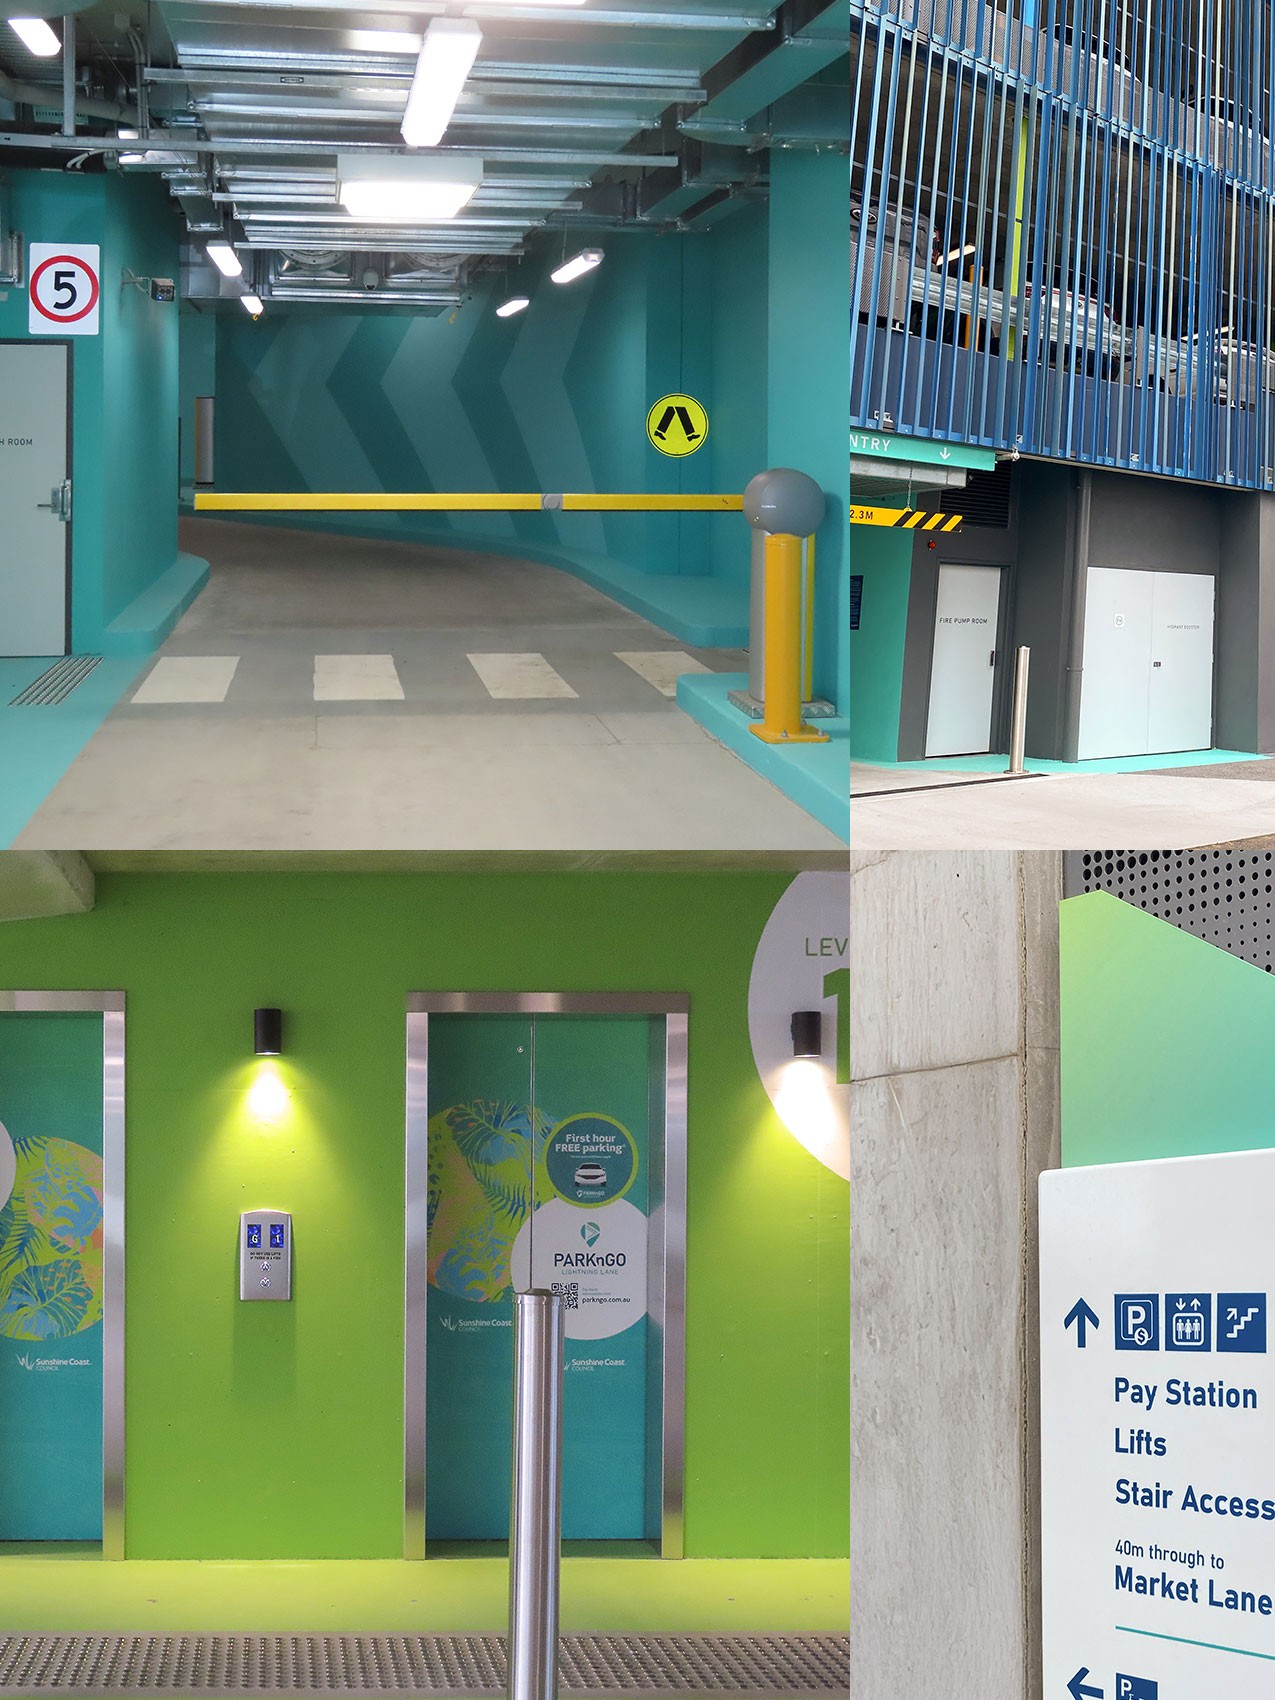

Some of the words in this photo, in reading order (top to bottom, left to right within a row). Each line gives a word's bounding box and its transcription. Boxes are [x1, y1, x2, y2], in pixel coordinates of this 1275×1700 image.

[53, 271, 77, 310] 5
[806, 938, 848, 956] LEV
[556, 1144, 580, 1152] FREE
[566, 1134, 591, 1142] First
[592, 1134, 616, 1142] hour
[554, 1253, 626, 1267] PARKnGO
[1115, 1377, 1158, 1410] Pay
[1166, 1379, 1257, 1408] Station
[1115, 1428, 1167, 1456] Lifts
[1116, 1479, 1173, 1508] Stair
[1181, 1485, 1275, 1520] Access
[1115, 1539, 1144, 1558] 40m
[1149, 1544, 1204, 1568] through
[1211, 1554, 1224, 1569] to
[1115, 1565, 1198, 1603] Market
[1209, 1579, 1273, 1615] Lane
